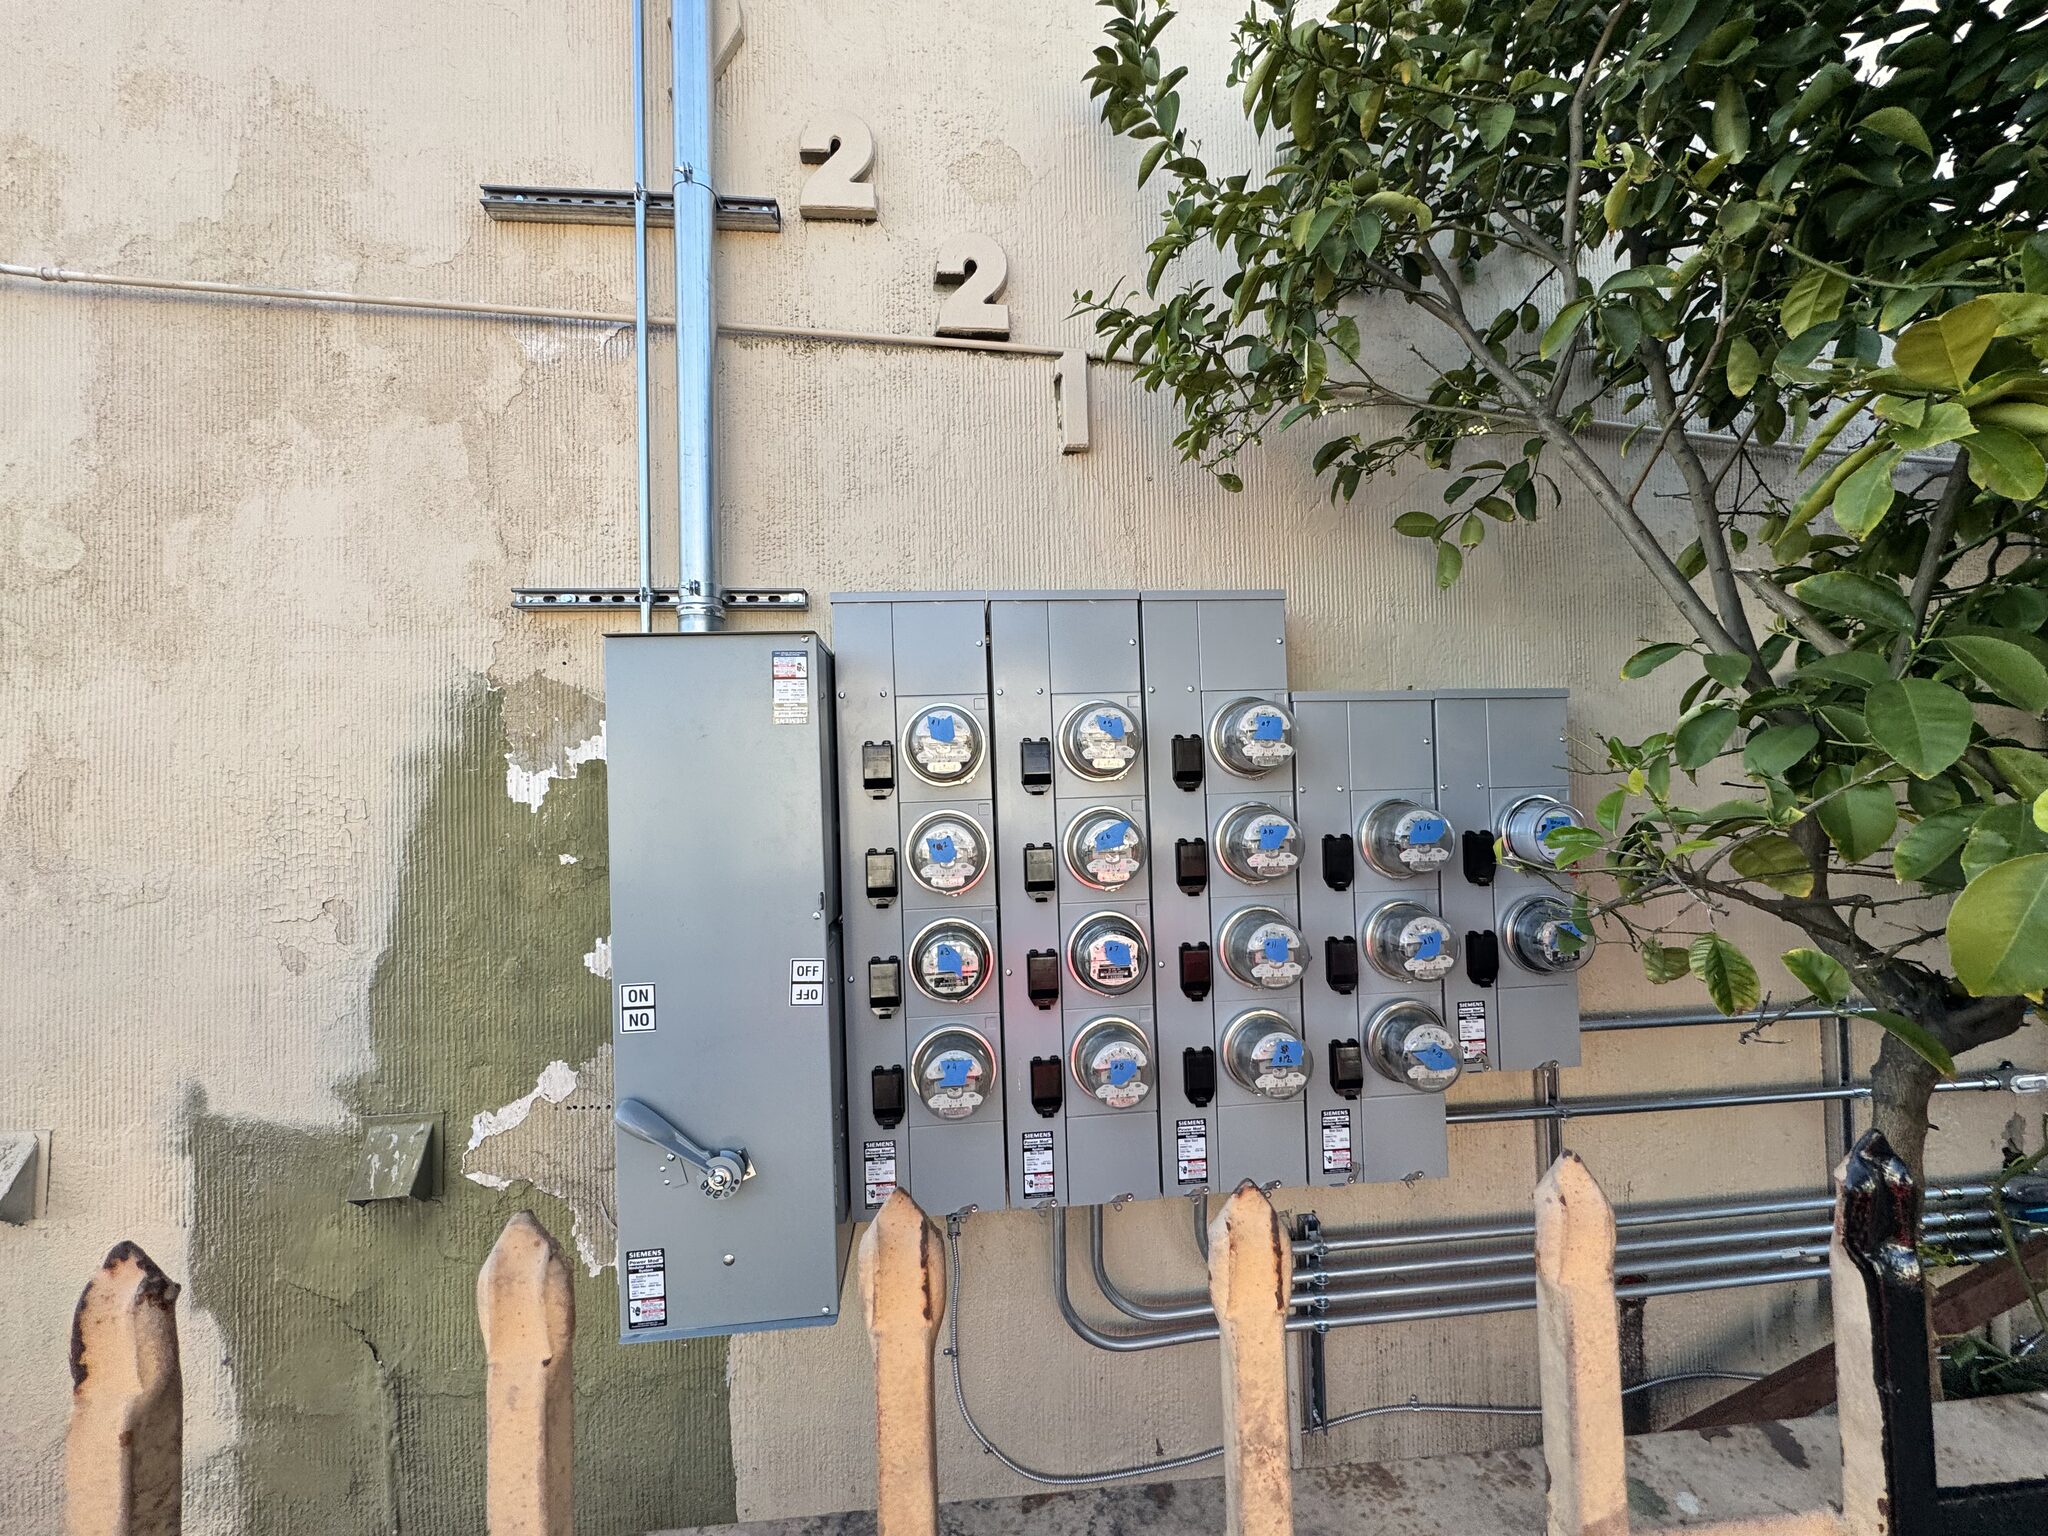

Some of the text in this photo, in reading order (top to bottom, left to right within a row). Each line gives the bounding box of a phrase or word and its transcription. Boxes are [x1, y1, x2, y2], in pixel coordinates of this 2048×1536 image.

[799, 113, 877, 221] 2
[934, 233, 1010, 339] 2
[796, 965, 819, 977] OFF
[628, 989, 649, 1003] ON
[796, 989, 818, 1001] OFF
[629, 1250, 662, 1259] SIEMENS
